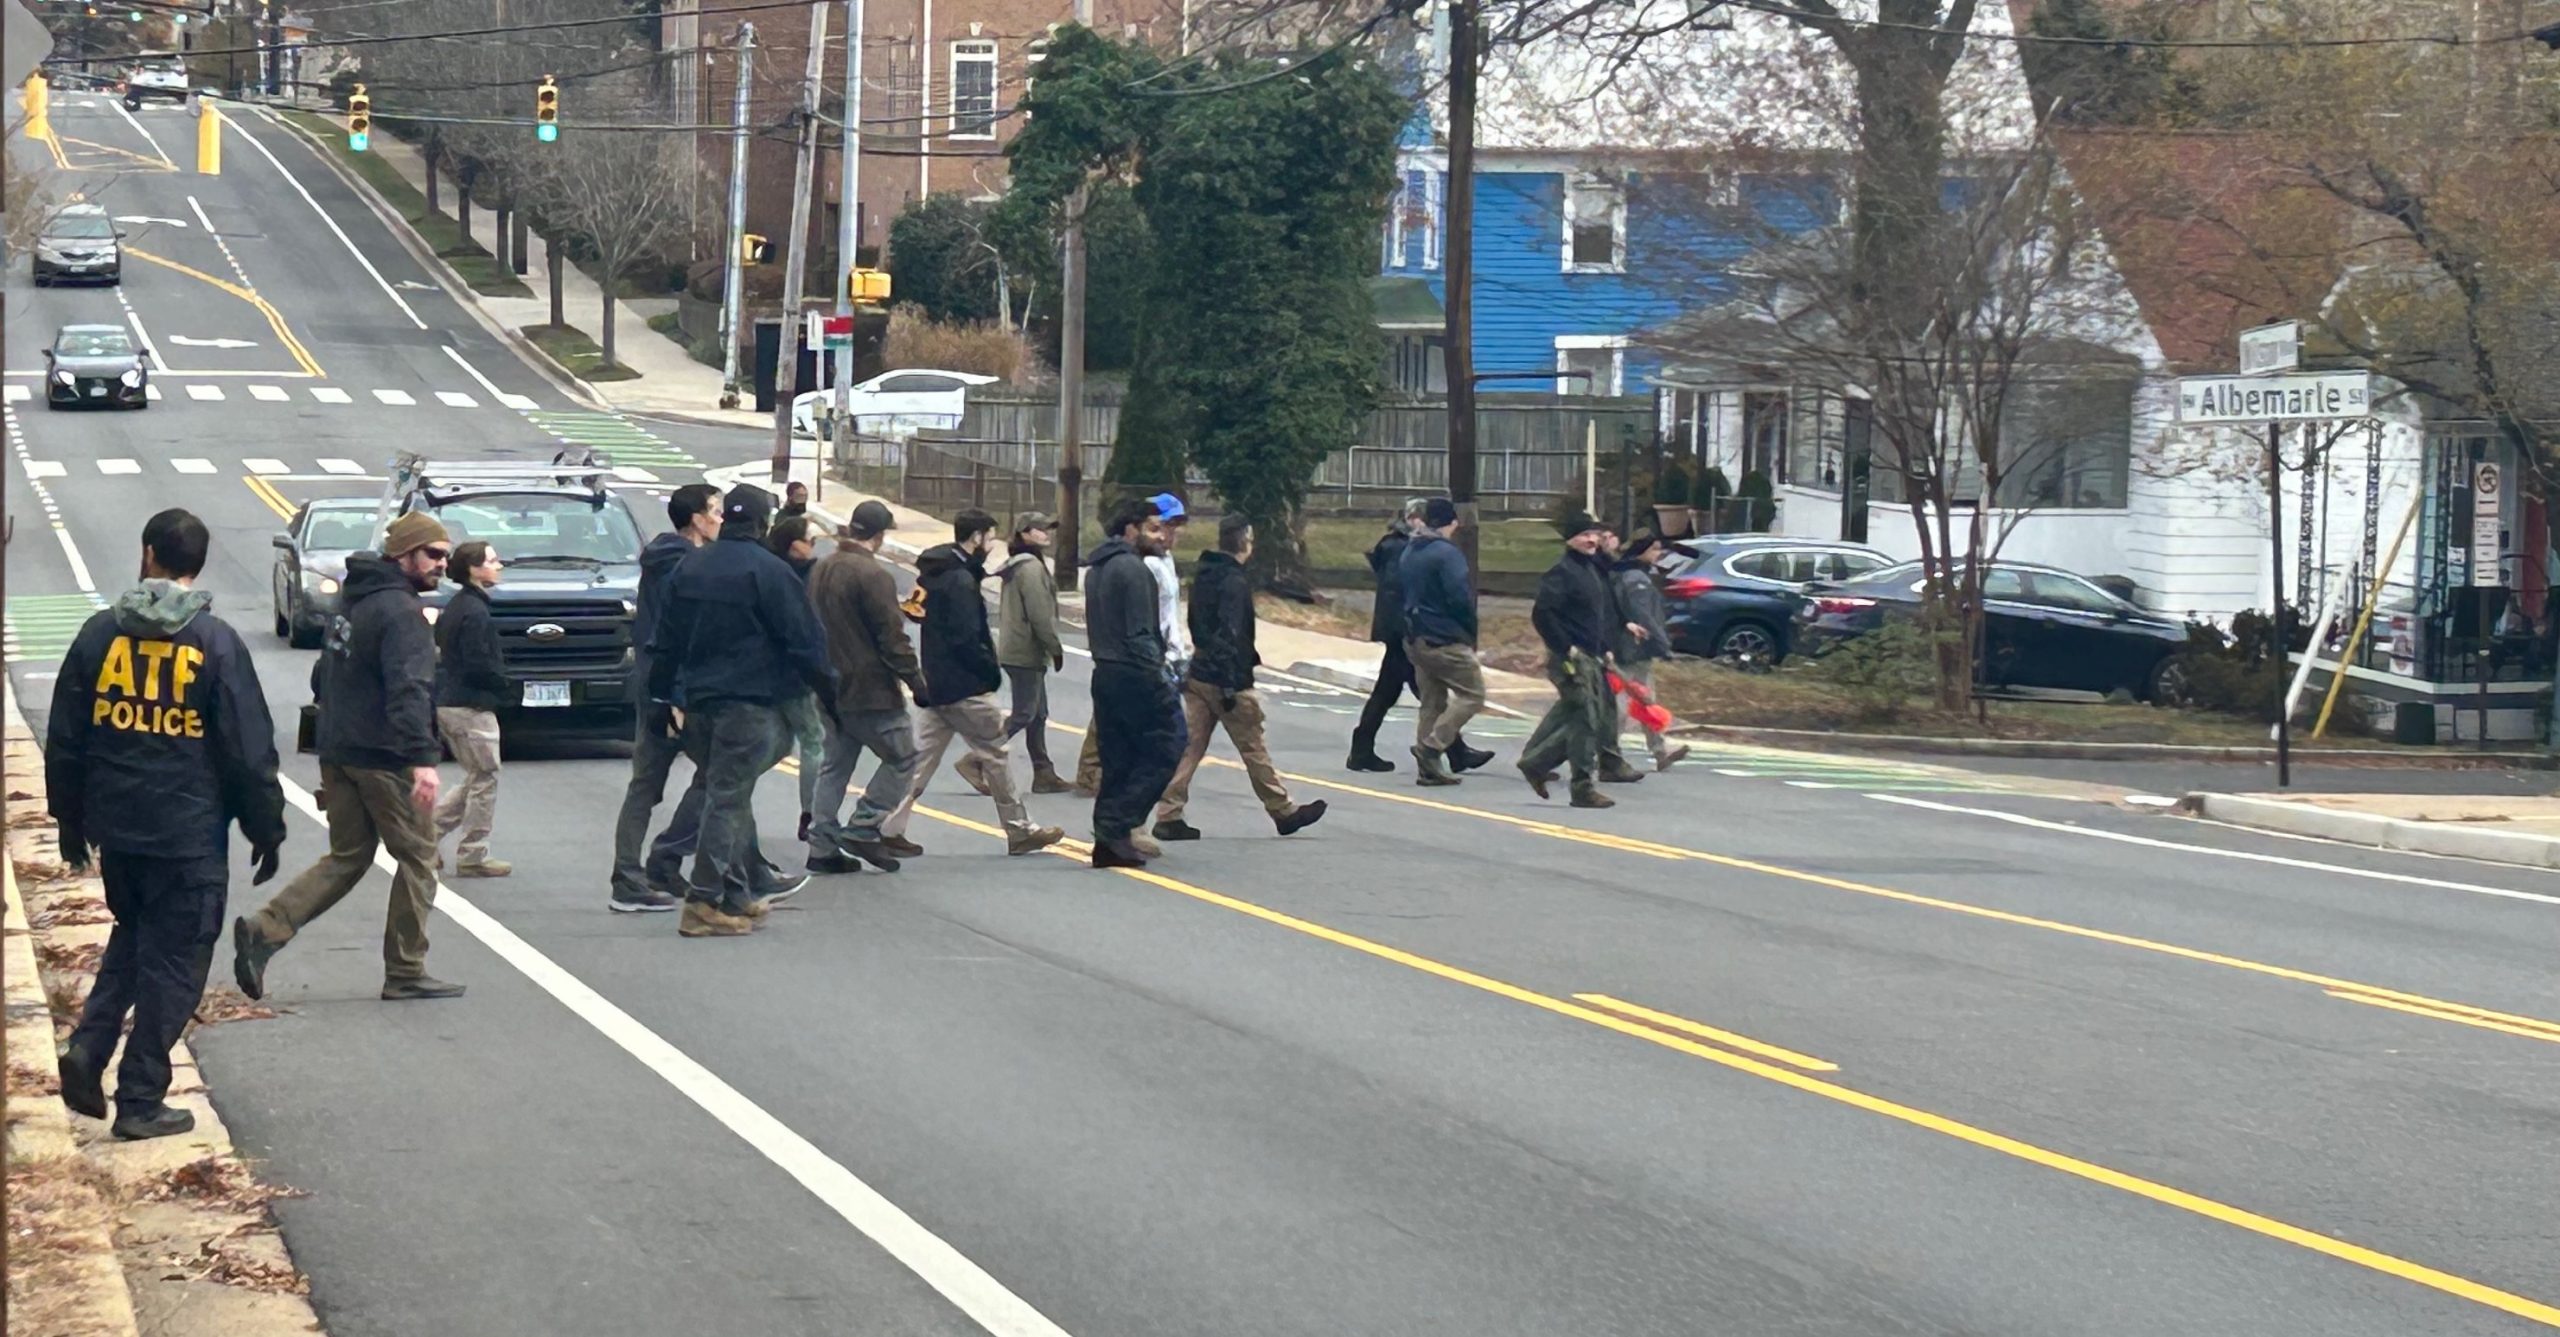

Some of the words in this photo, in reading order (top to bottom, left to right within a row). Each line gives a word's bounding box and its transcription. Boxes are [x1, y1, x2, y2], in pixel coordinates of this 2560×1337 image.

[2200, 382, 2341, 416] Albemarle
[96, 636, 204, 703] ATF
[93, 698, 204, 738] POLICE
